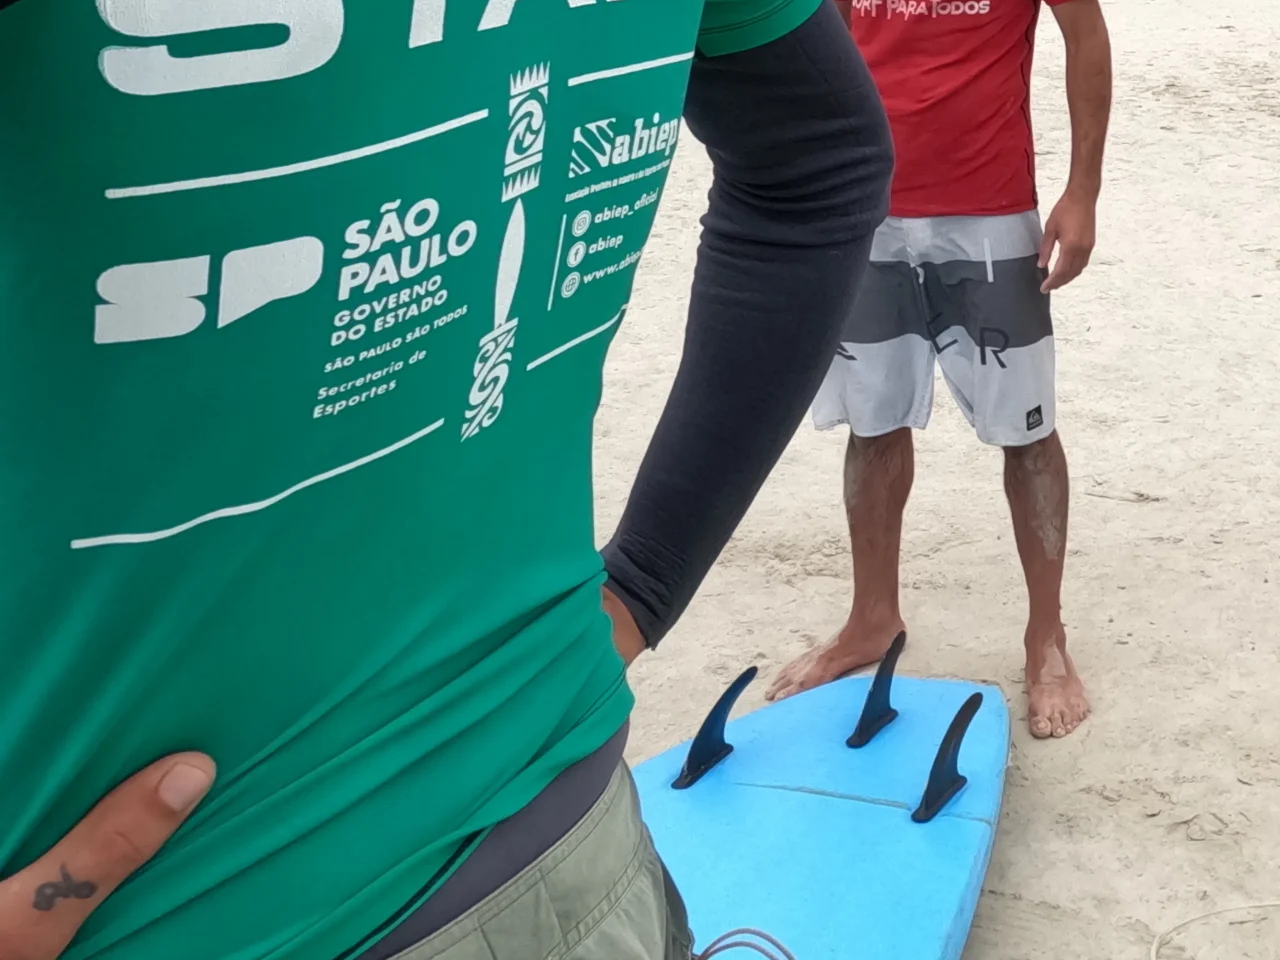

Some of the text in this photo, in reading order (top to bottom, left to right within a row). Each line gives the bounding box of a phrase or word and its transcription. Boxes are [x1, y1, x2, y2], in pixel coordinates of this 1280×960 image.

[611, 112, 679, 165] abiep
[342, 198, 440, 259] SÃO
[588, 234, 624, 254] abiep
[338, 220, 477, 301] PAULO
[330, 289, 448, 346] DO ESTADO
[333, 275, 442, 327] GOVERNO
[324, 304, 468, 373] SÃO PAULO SÃO TODOS
[312, 380, 397, 419] Esportes
[317, 349, 427, 400] Secretaria de
